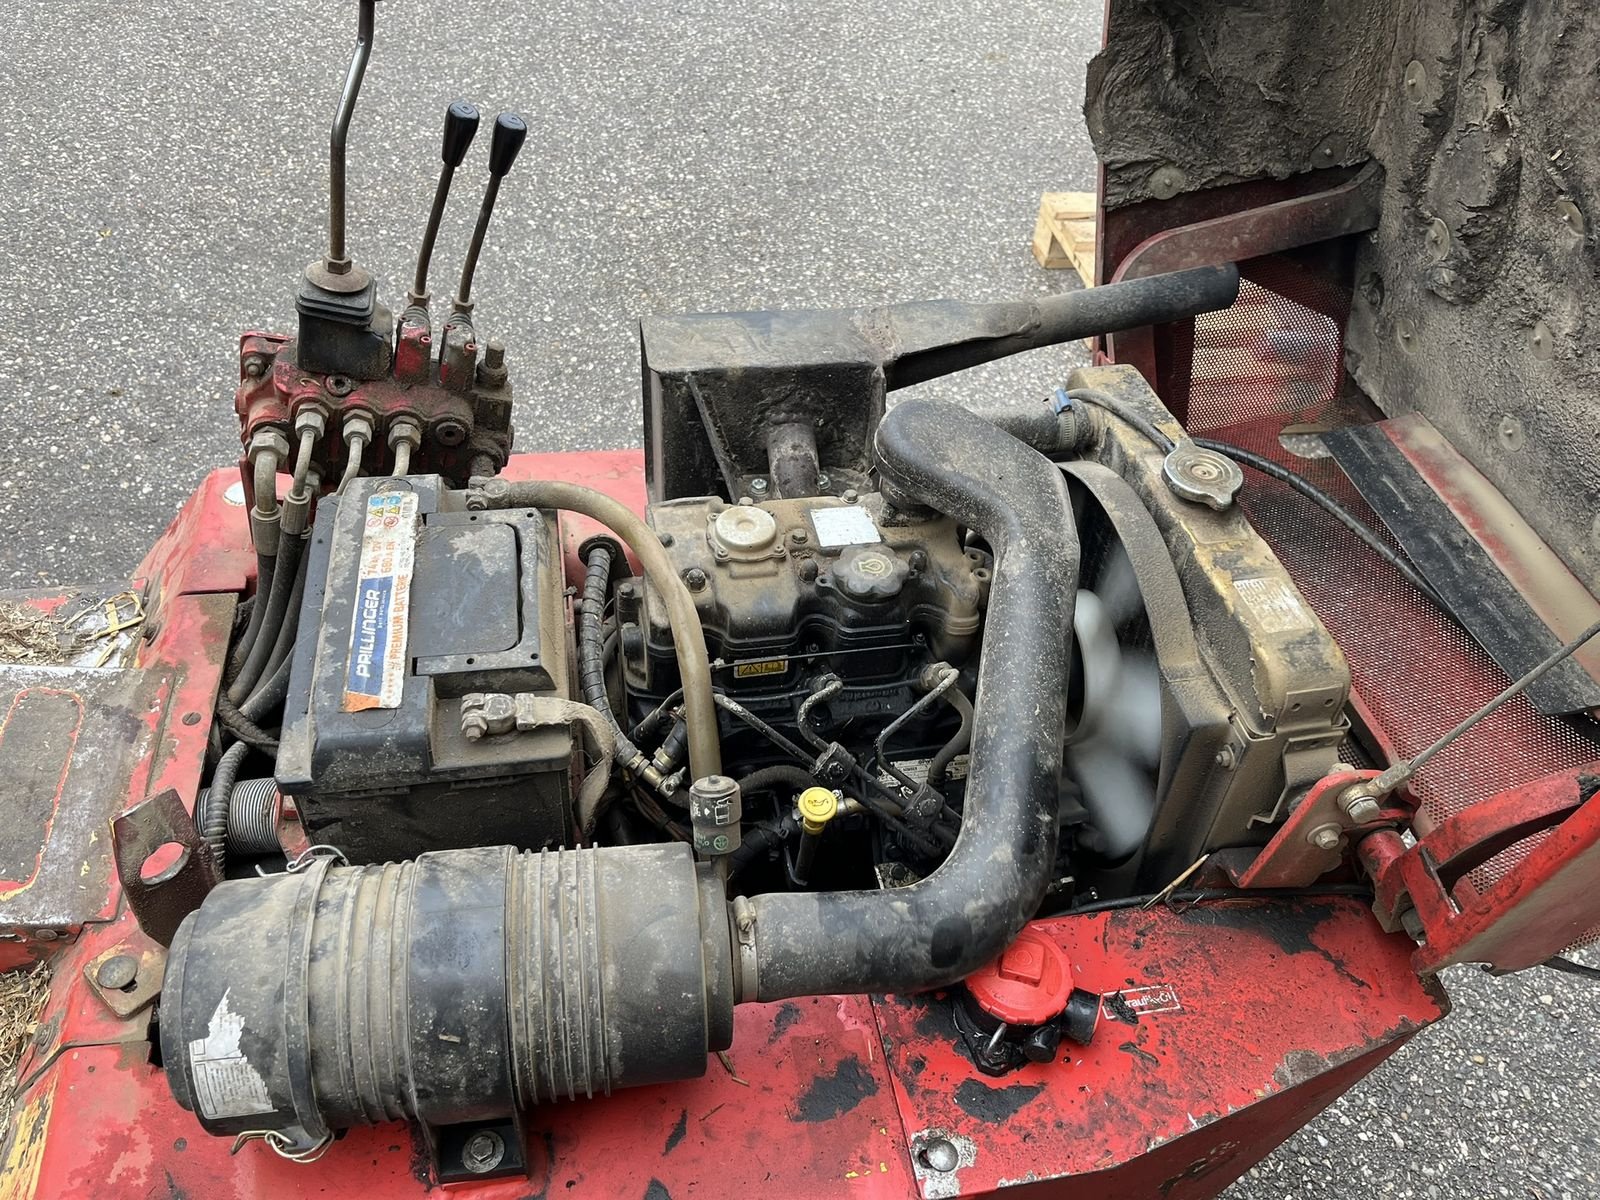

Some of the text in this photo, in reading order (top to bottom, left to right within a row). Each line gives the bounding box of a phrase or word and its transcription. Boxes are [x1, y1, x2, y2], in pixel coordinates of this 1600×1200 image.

[393, 574, 408, 613] BATTERIE
[356, 589, 381, 678] PRILLINGER
[389, 615, 405, 659] PREMIUM
